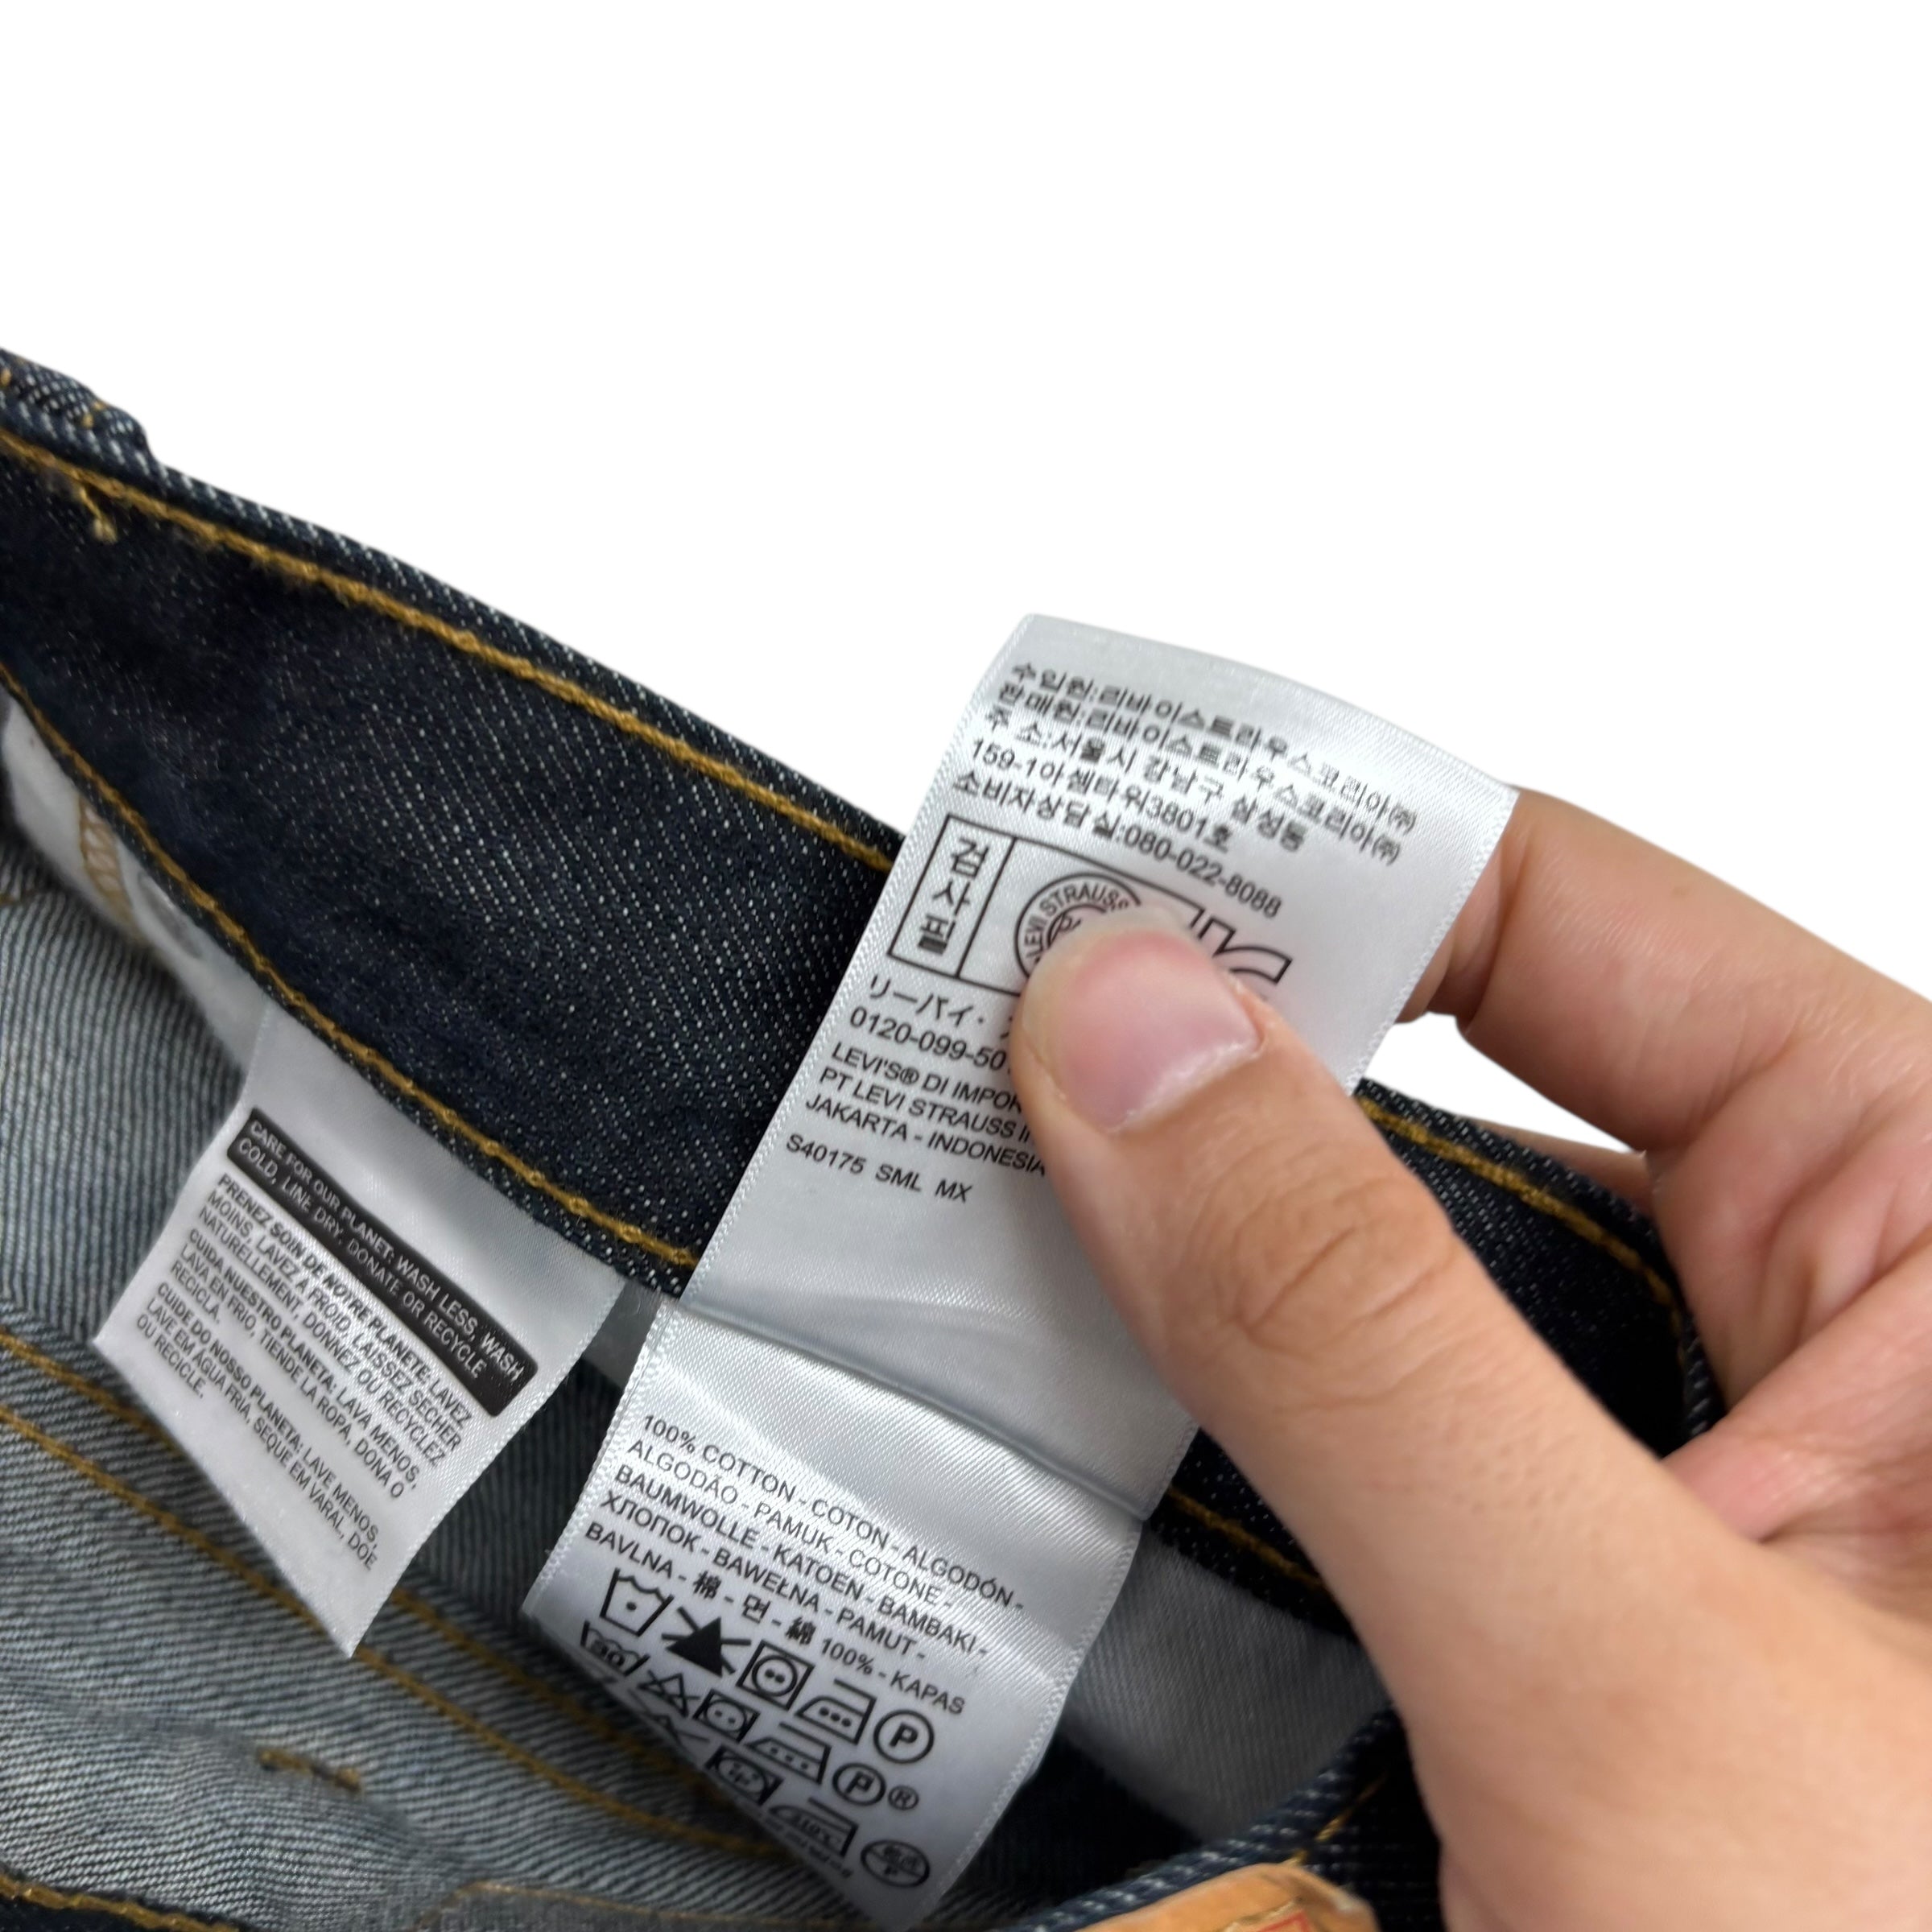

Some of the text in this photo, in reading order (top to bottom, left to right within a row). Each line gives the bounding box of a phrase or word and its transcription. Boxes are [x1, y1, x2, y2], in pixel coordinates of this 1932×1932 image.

[1231, 794, 1309, 852] 삼성동
[806, 1094, 907, 1141] JAKARTA
[927, 1131, 1045, 1177] INDONESIA
[819, 1067, 852, 1092] PT
[852, 1080, 906, 1110] LEVI
[908, 1098, 1017, 1140] STRAUSS
[849, 1006, 1009, 1074] 0120-099-50
[923, 1073, 950, 1094] DI
[239, 1137, 279, 1185] COLD,
[282, 1176, 313, 1212] LINE
[347, 1238, 402, 1295] DONATE
[403, 1290, 426, 1318] OR
[424, 1311, 486, 1378] RECYCLE
[250, 1120, 525, 1381] CARE FOR OUR PLANET: WASH LESS, WASH
[786, 1133, 972, 1203] S40175 SML MX
[137, 1314, 206, 1399] OU RECICLE.
[171, 1260, 221, 1324] RECICLA.
[181, 1244, 209, 1282] LAVA
[209, 1276, 229, 1301] EN
[260, 1328, 303, 1383] TIENDE
[300, 1377, 317, 1403] LA
[317, 1396, 353, 1446] ROPA,
[354, 1438, 392, 1487] DONA
[390, 1481, 404, 1499] O
[190, 1228, 419, 1490] CUIDA NUESTRO PLANETA: LAVA MENOS,
[200, 1206, 446, 1467] NATURELLEMENT, DONNEZ OU RECYCLEZ
[208, 1189, 253, 1244] MOINS,
[256, 1235, 300, 1282] LAVEZ
[352, 1332, 414, 1395] LAISSEZ
[217, 1172, 273, 1228] PRENEZ
[270, 1222, 307, 1258] SOIN
[303, 1253, 328, 1278] DE
[322, 1273, 373, 1322] NOTRE
[429, 1379, 472, 1429] LAVEZ
[147, 1298, 378, 1571] LAVE EM ÁGUA FRIA, SEQUE EM VARAL, DOE
[158, 1282, 379, 1550] CUIDE DO NOSSO PLANETA: LAVE MENOS,
[644, 1414, 697, 1455] 100%
[702, 1443, 796, 1503] COTTON
[811, 1498, 890, 1550] COTON
[902, 1545, 1014, 1608] ALGODÓN
[585, 1521, 674, 1579] BAVLNA
[741, 1594, 771, 1624] 면
[821, 1637, 876, 1676] 100%
[890, 1670, 965, 1715] KAPAS
[601, 1490, 702, 1553] ХЛОПОК
[712, 1547, 819, 1613] BAWEŁNA
[836, 1608, 918, 1656] PAMUT
[615, 1463, 760, 1550] BAUMWOLLE
[773, 1544, 865, 1601] KATOEN
[877, 1596, 977, 1653] BAMBAKI
[627, 1439, 738, 1505] ALGODÃO
[753, 1501, 833, 1554] PAMUK
[848, 1549, 943, 1608] COTONE
